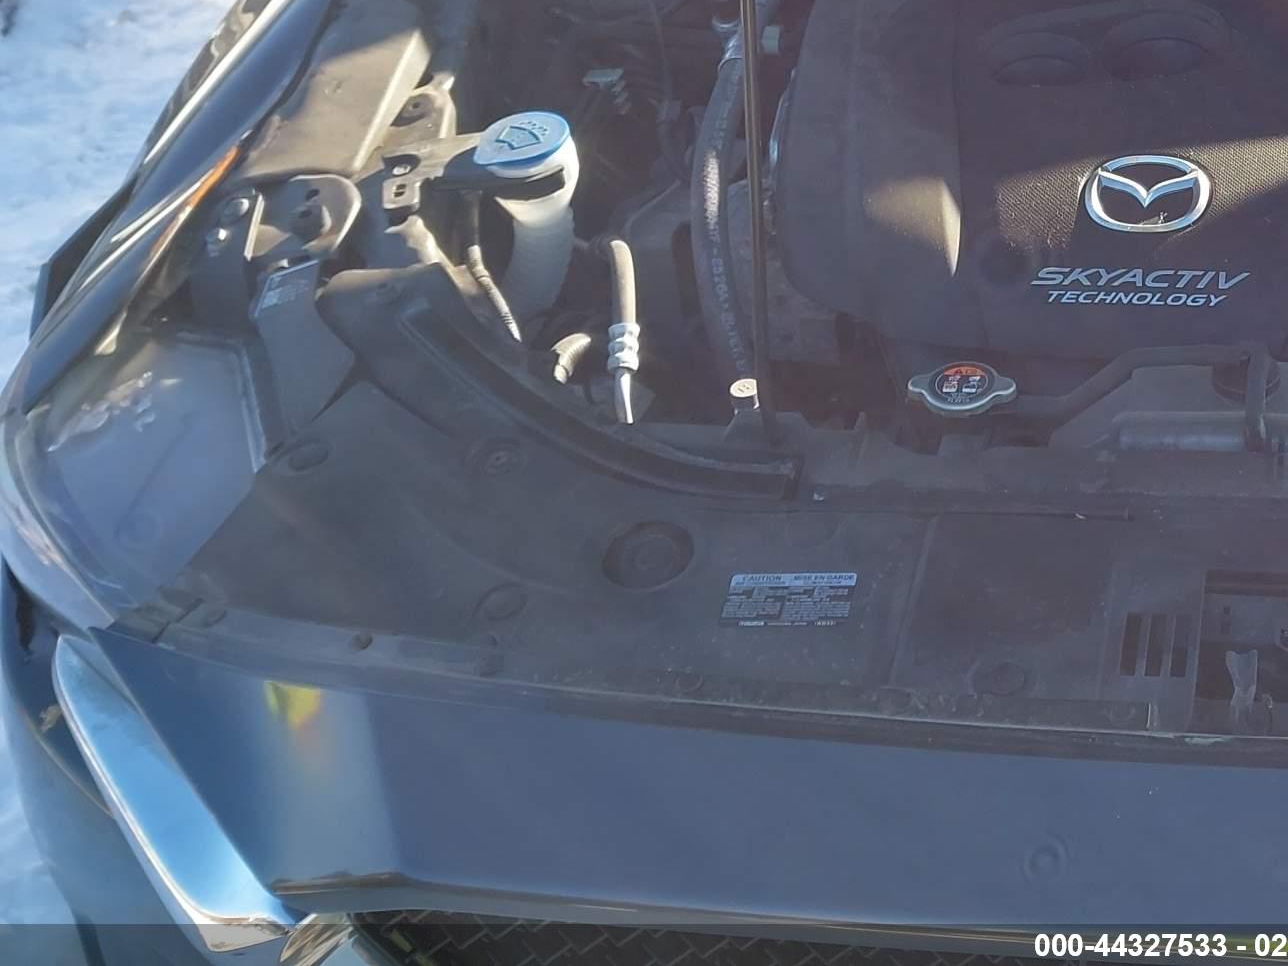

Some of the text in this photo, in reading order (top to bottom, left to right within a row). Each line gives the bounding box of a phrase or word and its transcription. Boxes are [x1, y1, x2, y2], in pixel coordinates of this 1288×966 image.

[1031, 267, 1251, 290] SKYACTIV
[1047, 290, 1228, 307] TECHNOLOGY
[741, 574, 782, 582] CAUTION
